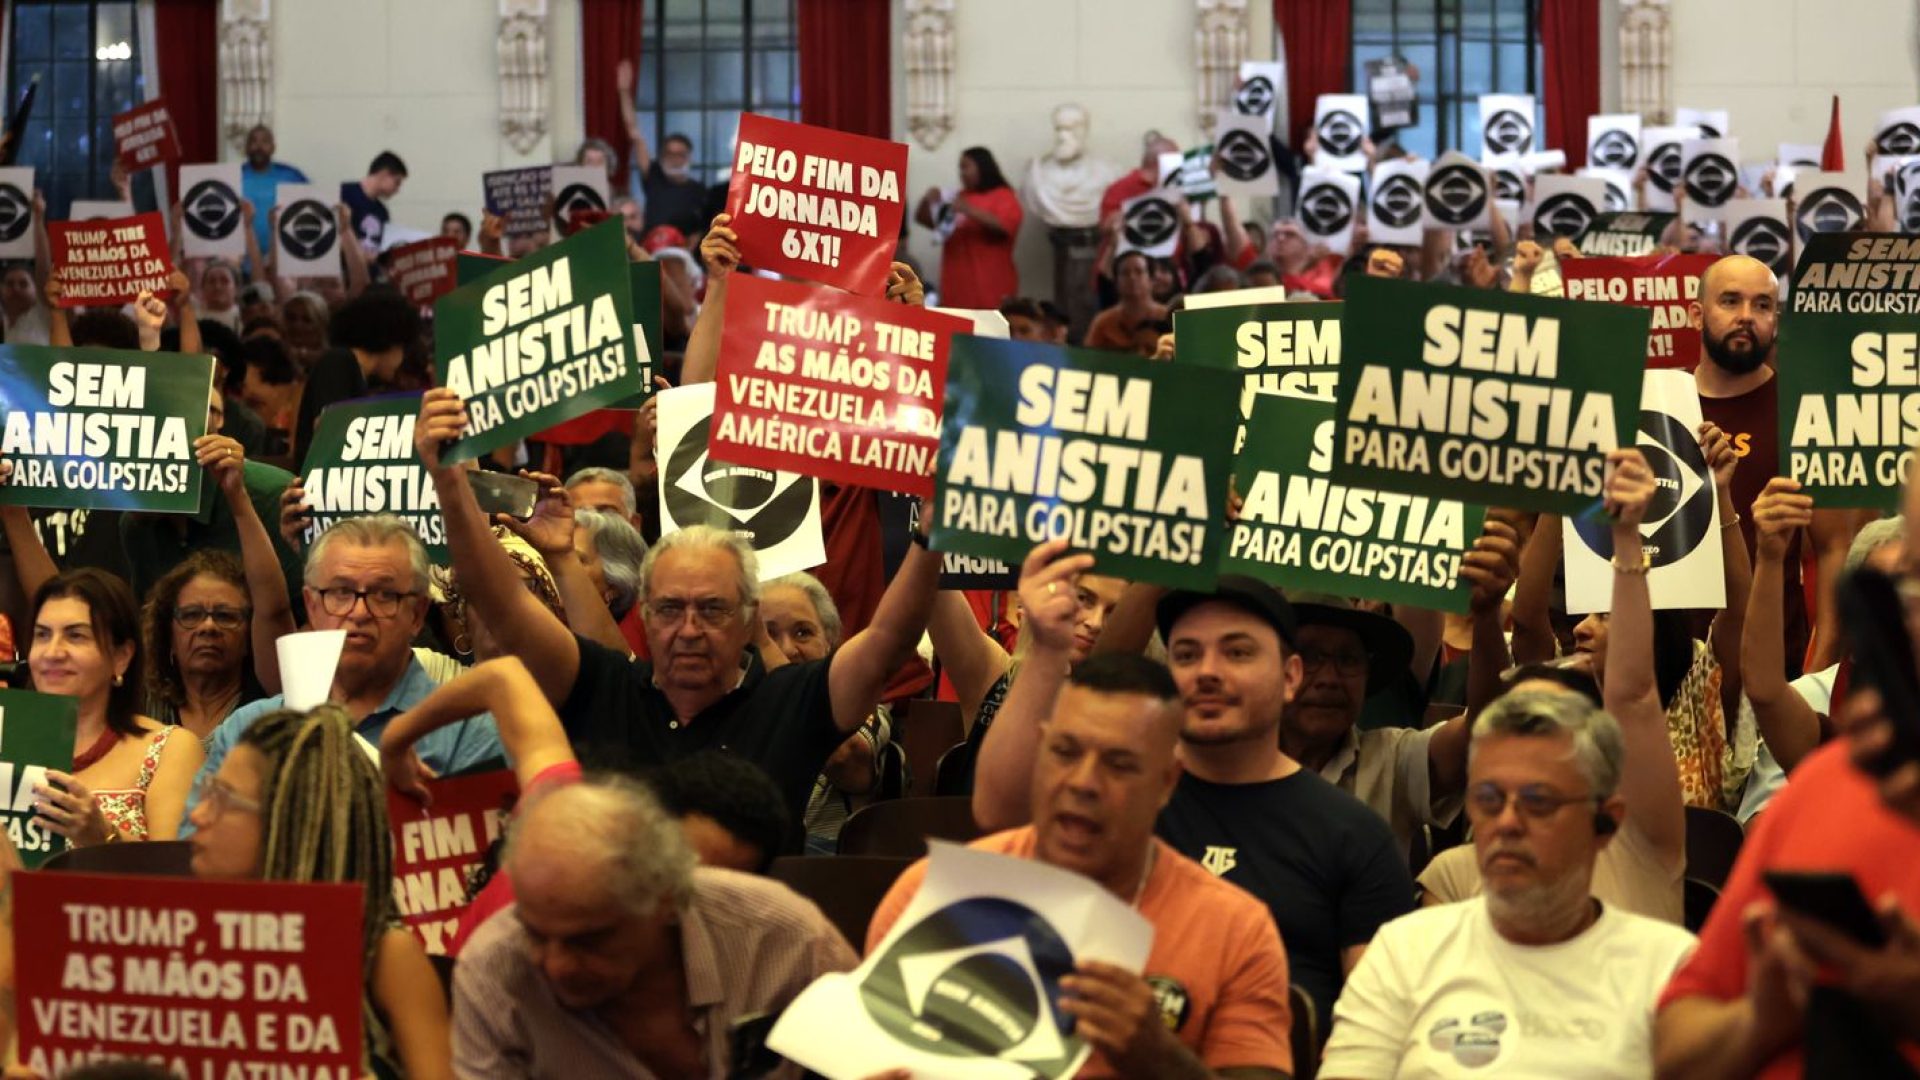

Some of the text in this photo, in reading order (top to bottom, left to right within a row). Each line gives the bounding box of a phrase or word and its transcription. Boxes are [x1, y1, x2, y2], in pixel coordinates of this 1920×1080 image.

[736, 141, 899, 204] PELO FIM DA
[64, 225, 145, 247] TRUMP, TIRE
[744, 183, 878, 238] JORNADA
[60, 259, 165, 281] VENEZUELA E DA
[68, 249, 85, 263] AS
[130, 243, 150, 259] DA
[781, 228, 841, 268] 6X1!
[482, 256, 573, 336] SEM
[1567, 276, 1701, 302] PELO FIM D
[1794, 291, 1843, 313] PARA
[446, 293, 624, 400] ANISTIA
[765, 302, 935, 362] TRUMP, TIRE
[1236, 320, 1341, 369] SEM
[1422, 304, 1560, 379] SEM
[48, 361, 146, 409] SEM
[755, 341, 934, 399] AS MÃOS DA
[1851, 331, 1920, 387] SE
[459, 394, 504, 440] ARA
[505, 343, 627, 419] GOLPSTAS!
[729, 374, 886, 430] VENEZUELA
[1016, 363, 1152, 442] SEM
[1347, 364, 1619, 454] ANISTIA
[2, 411, 190, 460] ANISTIA
[341, 413, 417, 462] SEM
[716, 412, 842, 462] AMÉRICA
[1345, 427, 1430, 475] PARA
[63, 460, 189, 493] GOLPSTAS!
[303, 465, 441, 513] ANISTIA
[947, 425, 1209, 521] ANISTIA
[1790, 451, 1868, 487] PARA
[942, 489, 1018, 539] PARA
[1025, 501, 1206, 566] GOLPSTAS!
[1239, 470, 1465, 550] ANISTIA
[1229, 524, 1463, 591] PARA GOLPSTAS!
[403, 812, 478, 864] FIM
[62, 903, 305, 955] TRUMP, TIRE
[62, 952, 308, 1003] AS MÃOS DA
[31, 997, 342, 1054] VENEZUELA E DA
